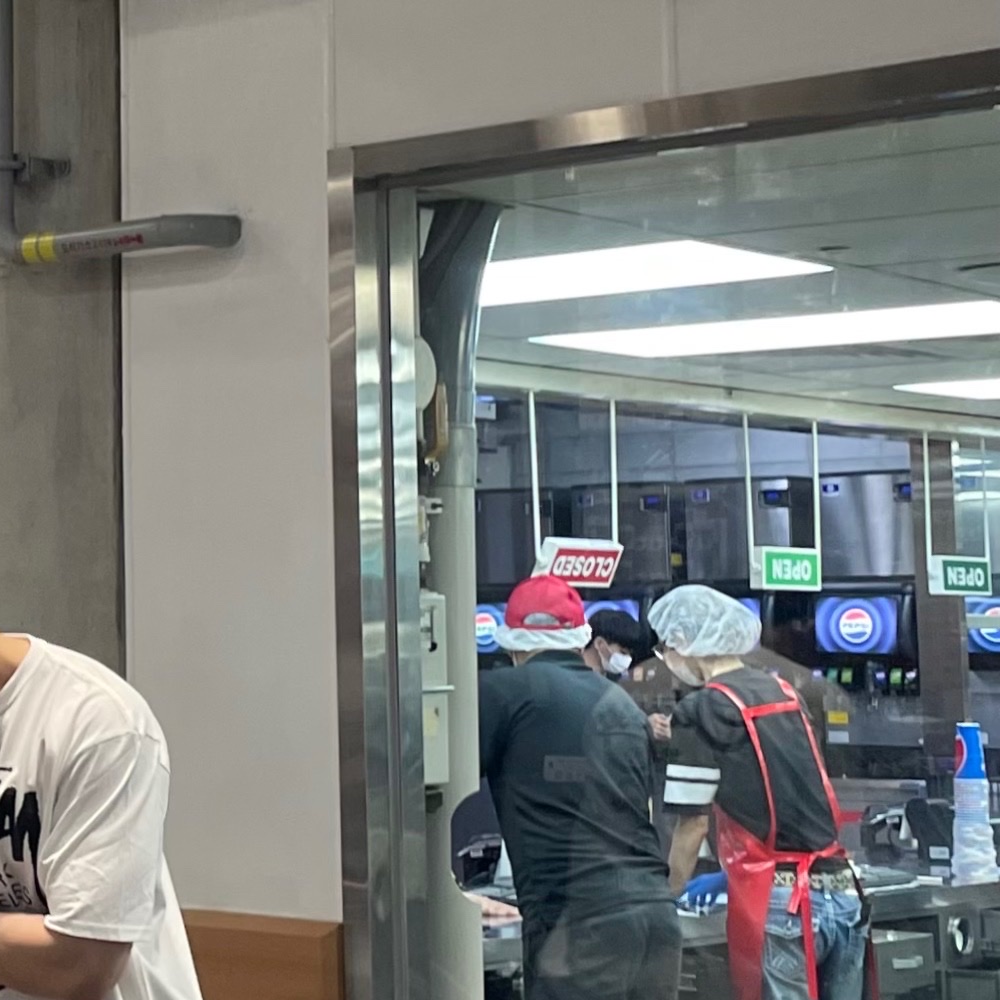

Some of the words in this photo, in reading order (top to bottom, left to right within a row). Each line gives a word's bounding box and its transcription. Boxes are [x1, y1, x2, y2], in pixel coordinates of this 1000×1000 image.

[552, 555, 615, 578] CLOSED
[772, 558, 812, 581] OPEN
[947, 566, 985, 588] OPEN
